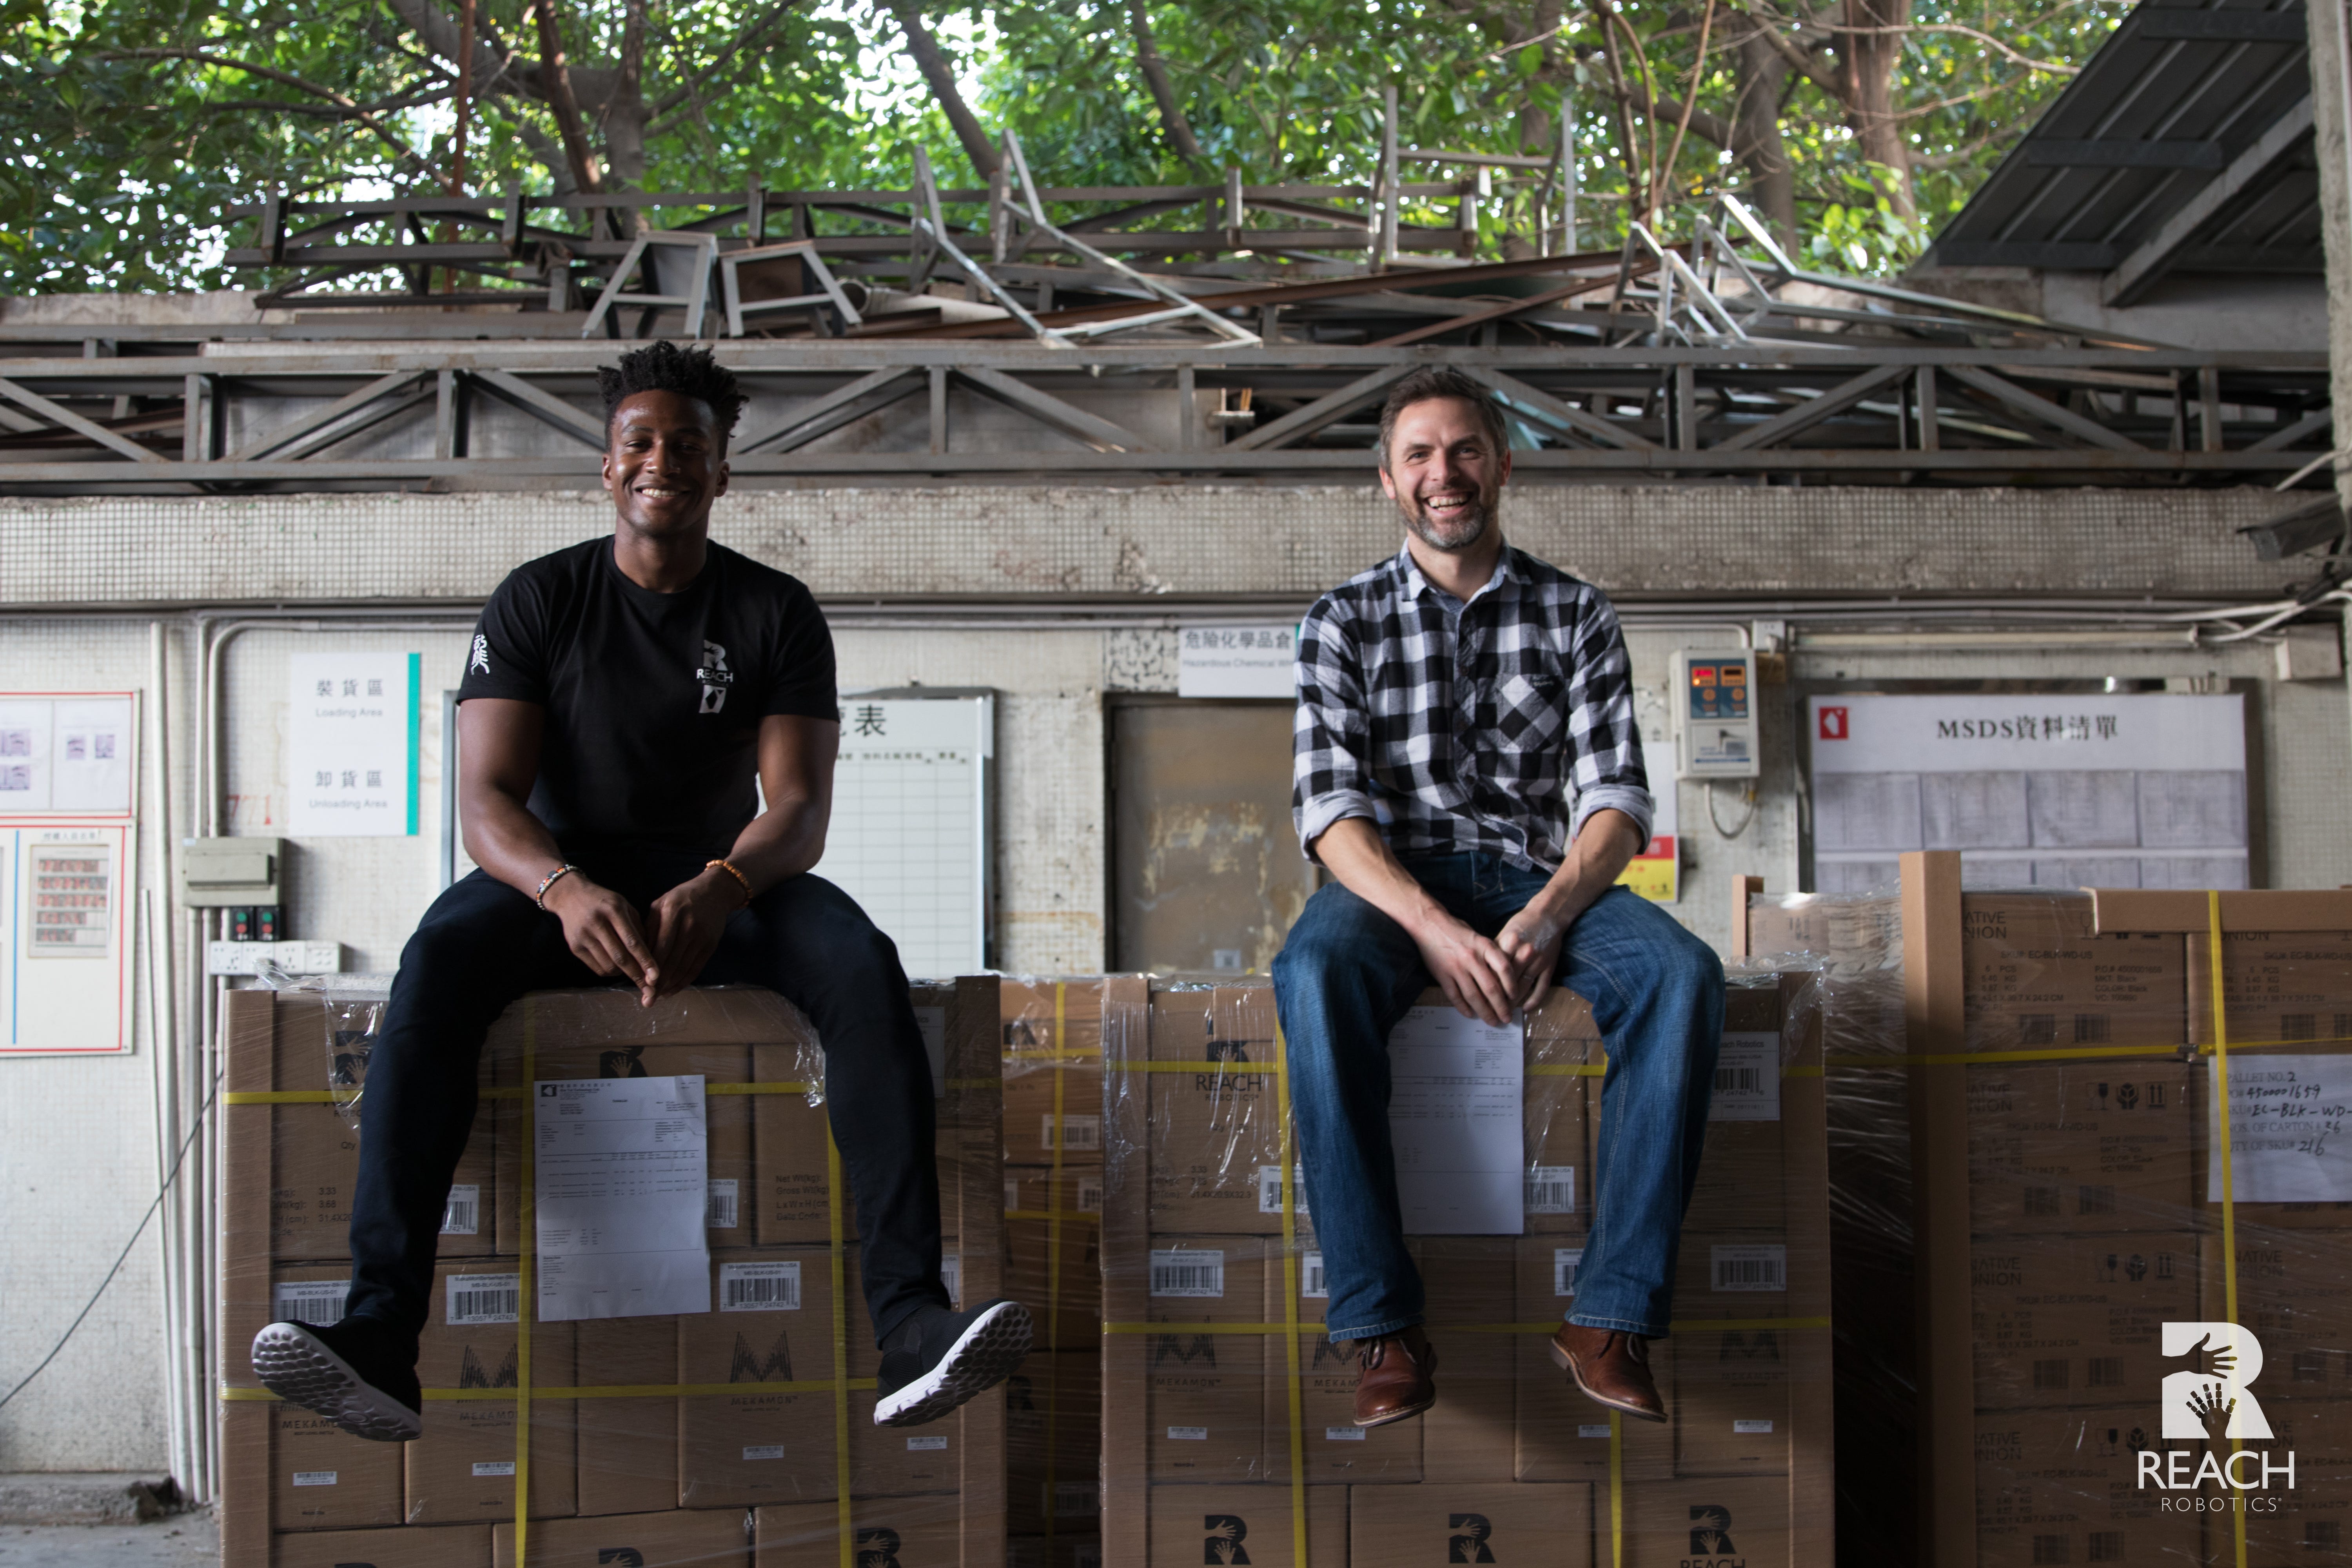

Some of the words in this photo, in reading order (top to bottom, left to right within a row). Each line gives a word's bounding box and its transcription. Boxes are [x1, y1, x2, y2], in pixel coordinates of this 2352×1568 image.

[697, 668, 733, 682] REACH
[316, 708, 356, 718] Loading
[359, 707, 383, 717] Area
[309, 799, 361, 809] Unloading
[363, 798, 387, 808] Area
[1965, 911, 2006, 924] ATIVE
[1965, 926, 2007, 939] NION
[2287, 1071, 2296, 1082] 2
[1196, 1074, 1261, 1091] REACH
[802, 1185, 830, 1195] Wt(kg)
[813, 1199, 829, 1209] (cm
[1314, 1378, 1357, 1387] MEKAM
[459, 1411, 514, 1421] MEKAMO
[1976, 1447, 2022, 1461] NION
